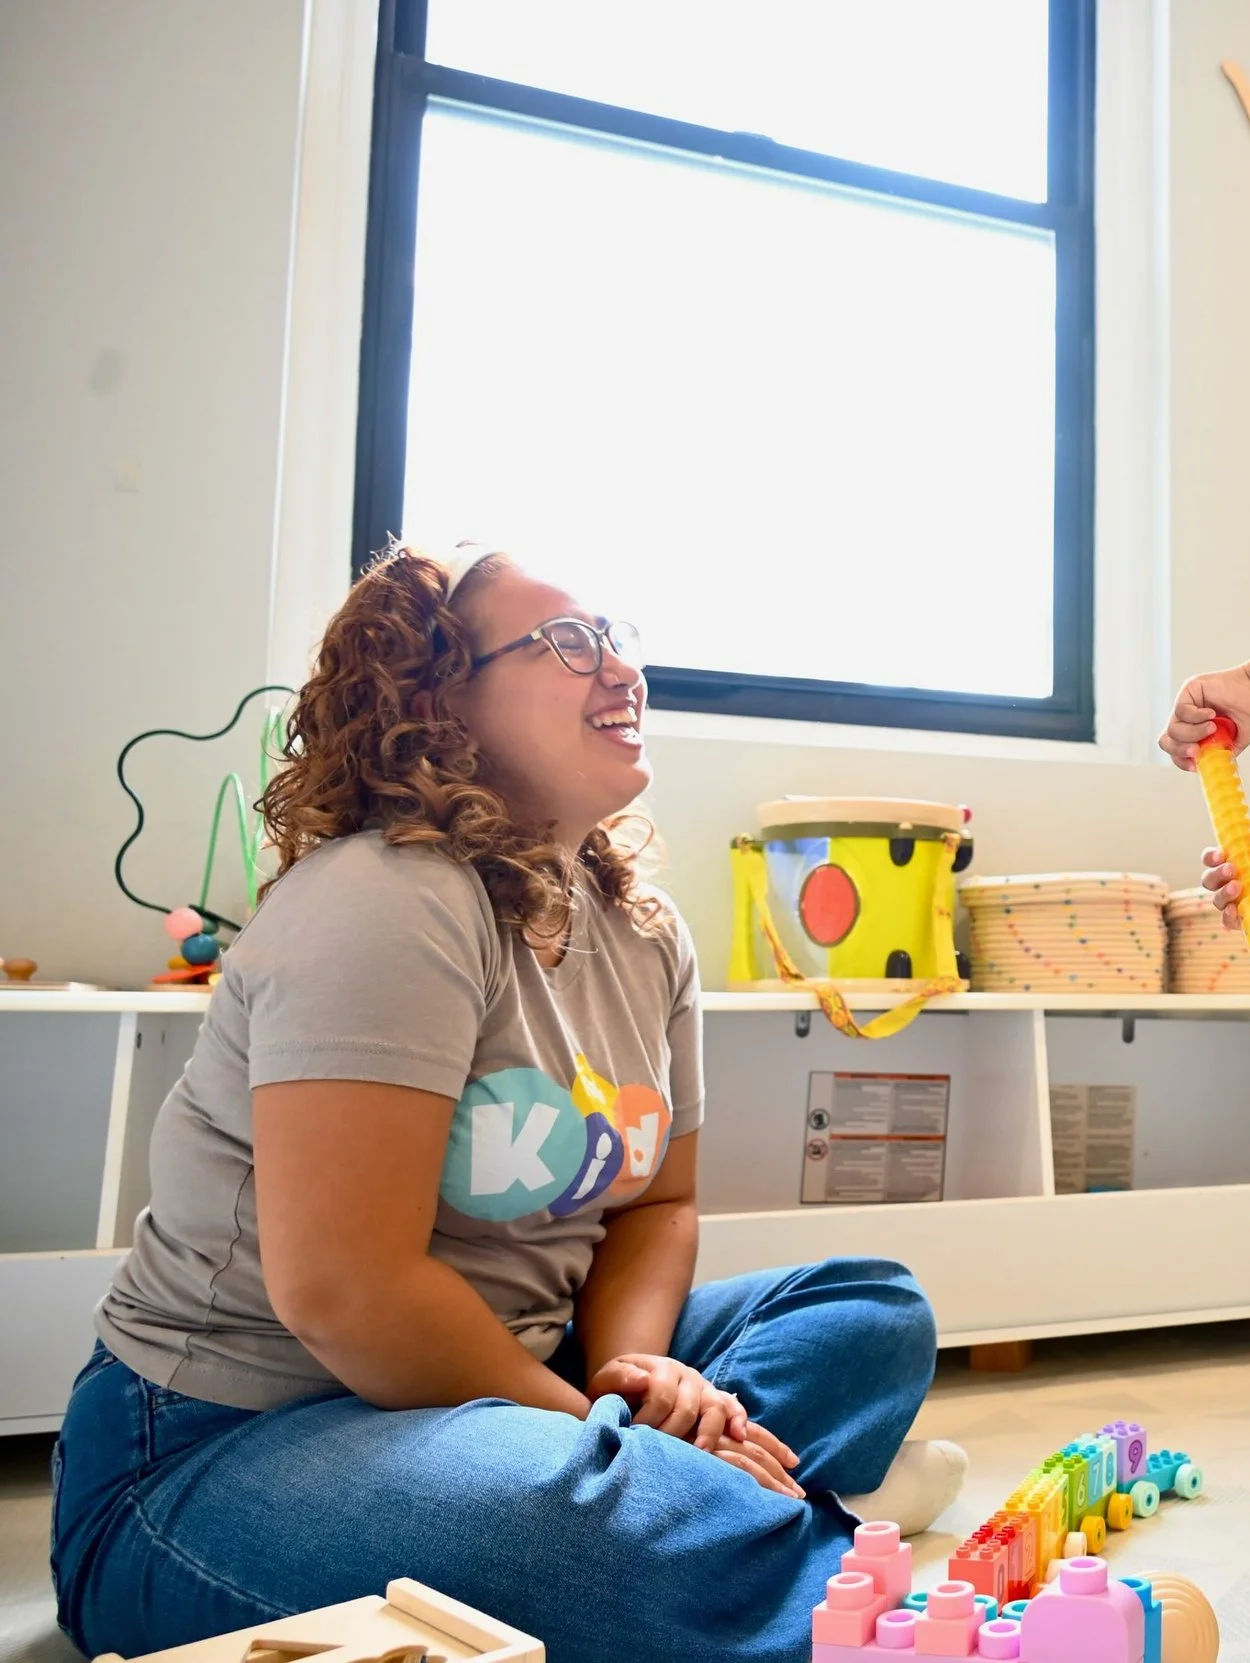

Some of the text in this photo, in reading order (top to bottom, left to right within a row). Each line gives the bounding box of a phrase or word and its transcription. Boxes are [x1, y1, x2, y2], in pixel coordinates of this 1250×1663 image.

[1105, 1452, 1114, 1486] 8
[1128, 1439, 1143, 1474] 9
[1078, 1471, 1086, 1507] 6
[1092, 1462, 1101, 1501] 7
